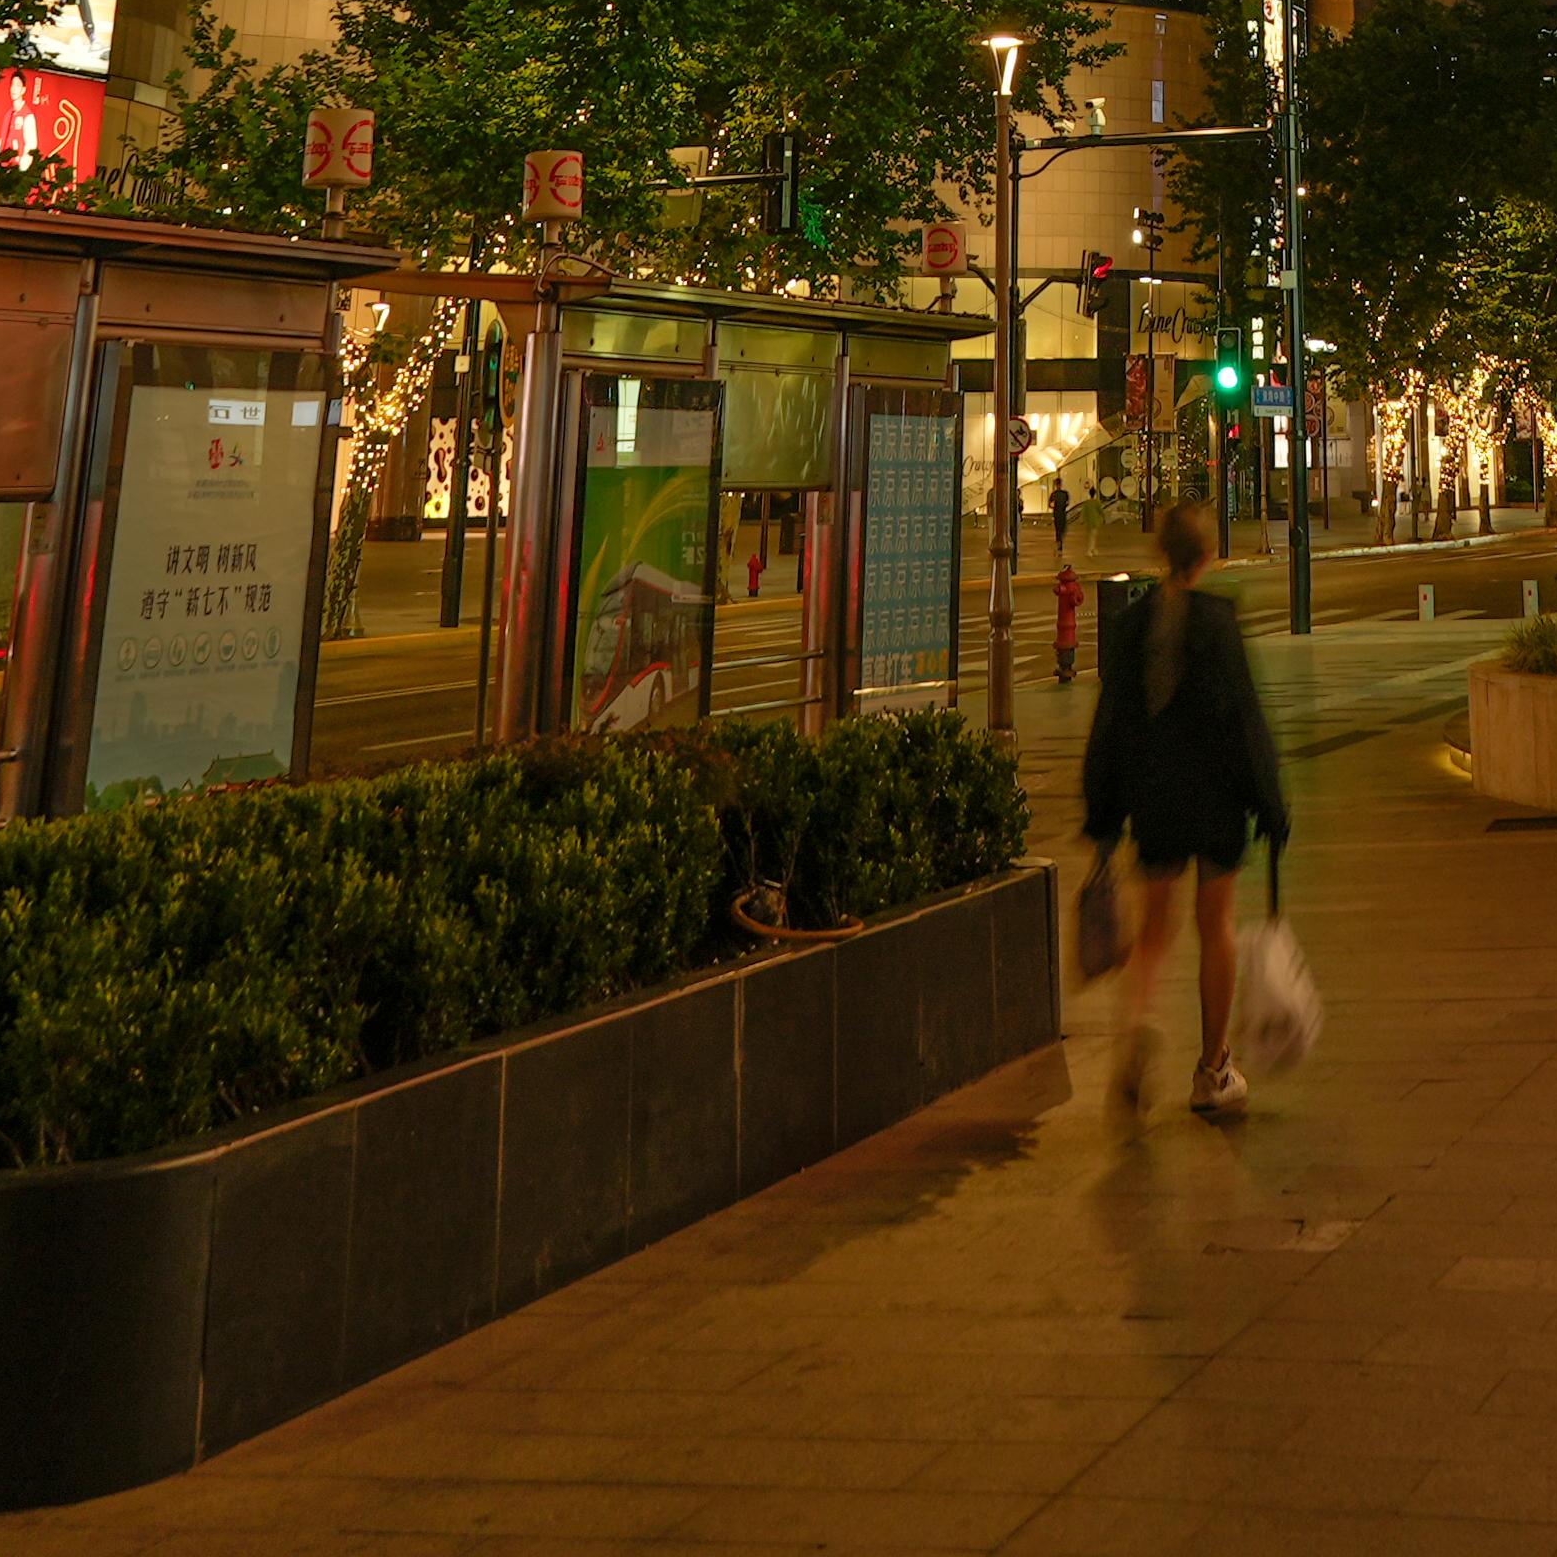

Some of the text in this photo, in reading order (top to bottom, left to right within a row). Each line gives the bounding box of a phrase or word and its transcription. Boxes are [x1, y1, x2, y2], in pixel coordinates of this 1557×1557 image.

[165, 543, 258, 576] 讲文明 树新风
